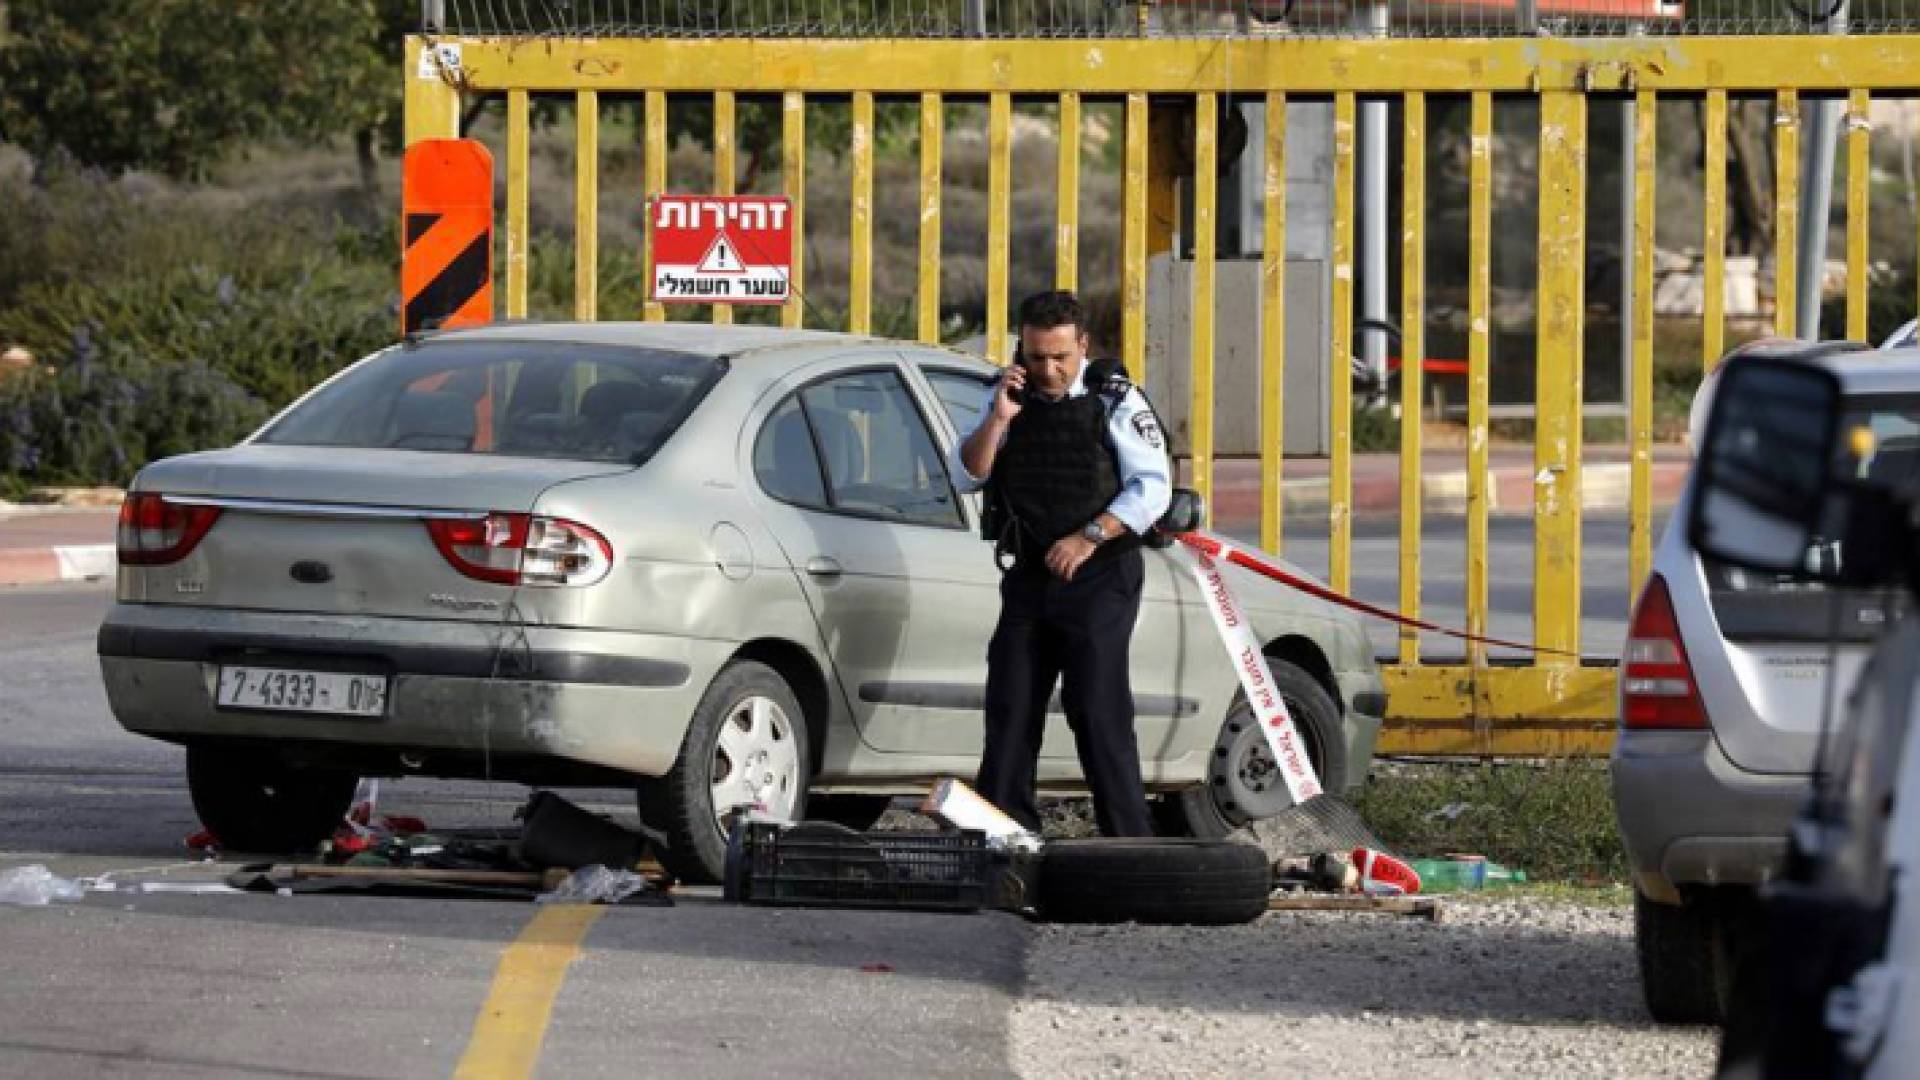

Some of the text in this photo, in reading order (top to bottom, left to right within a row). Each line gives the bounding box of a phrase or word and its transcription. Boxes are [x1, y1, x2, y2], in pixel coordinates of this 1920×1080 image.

[656, 201, 787, 230] זהירות
[658, 272, 786, 295] שער חשמלי
